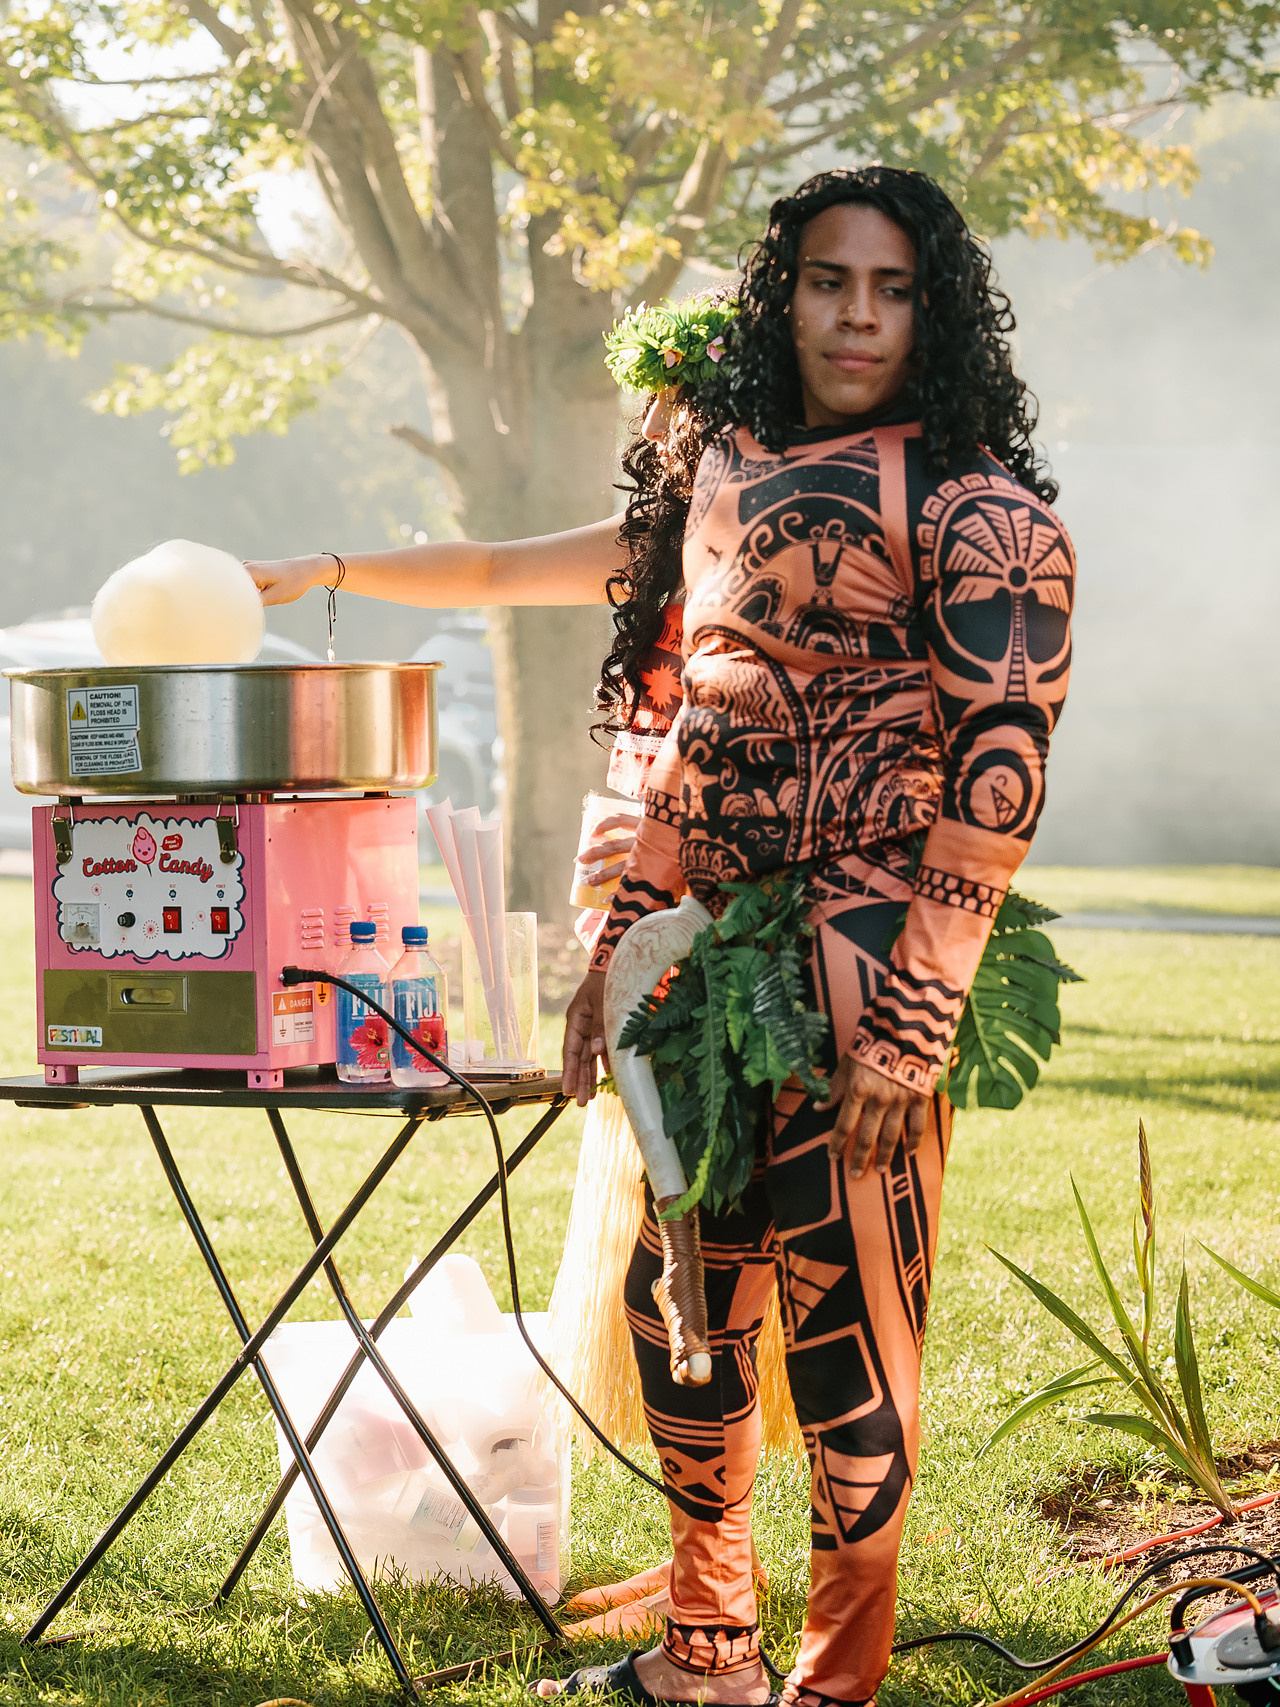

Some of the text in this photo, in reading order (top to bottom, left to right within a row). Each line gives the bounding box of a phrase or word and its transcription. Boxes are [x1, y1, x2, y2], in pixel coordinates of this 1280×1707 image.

[82, 853, 214, 883] Cotton Candy
[289, 998, 312, 1008] DANGER
[351, 989, 385, 1016] FIJI
[405, 991, 441, 1018] FIJI
[49, 1028, 101, 1044] FESTIVAL
